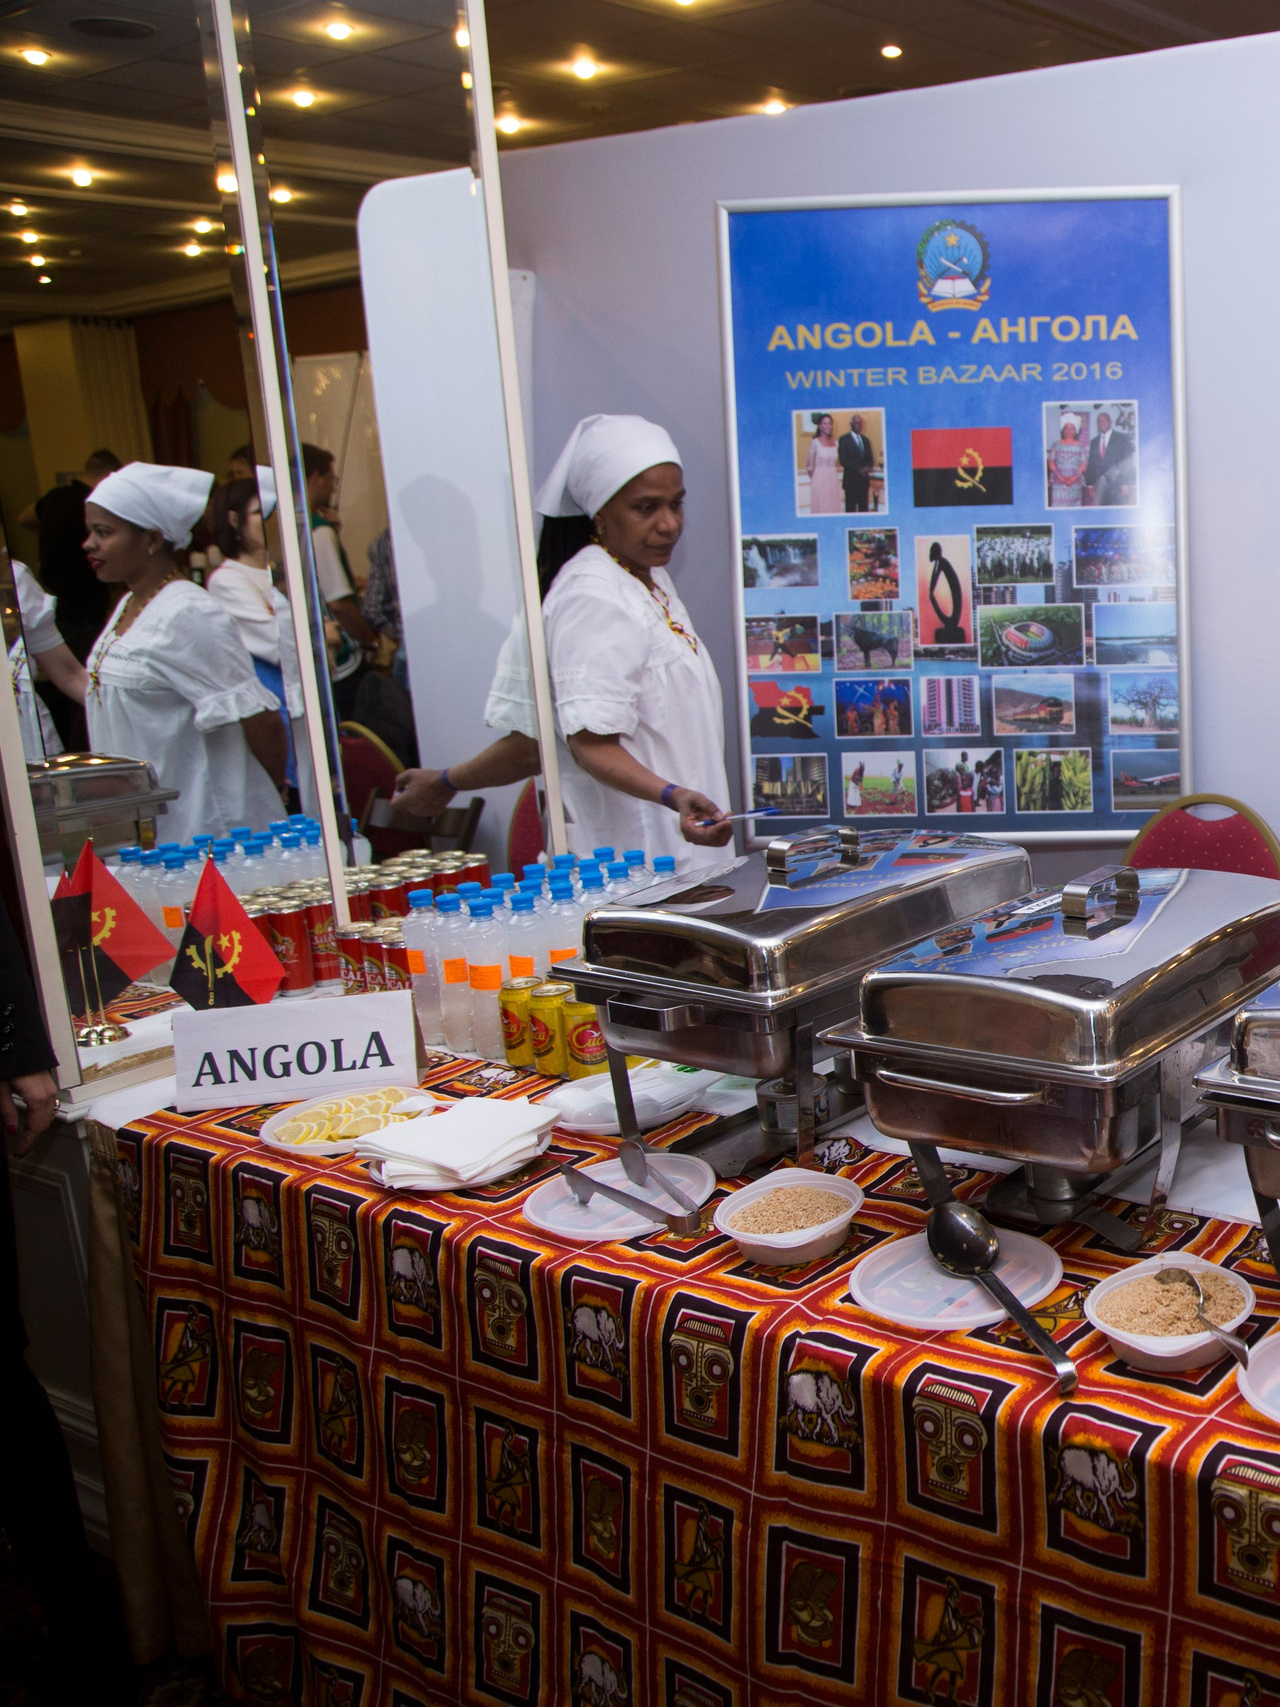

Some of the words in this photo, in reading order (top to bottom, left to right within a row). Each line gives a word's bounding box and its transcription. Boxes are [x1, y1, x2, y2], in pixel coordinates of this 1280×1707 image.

[767, 319, 936, 352] ANGOLA
[971, 314, 1139, 345] АНГОЛА
[785, 366, 908, 390] WINTER
[918, 364, 1043, 386] BAZAAR
[1051, 362, 1124, 383] 2016
[191, 1030, 395, 1088] ANGOLA
